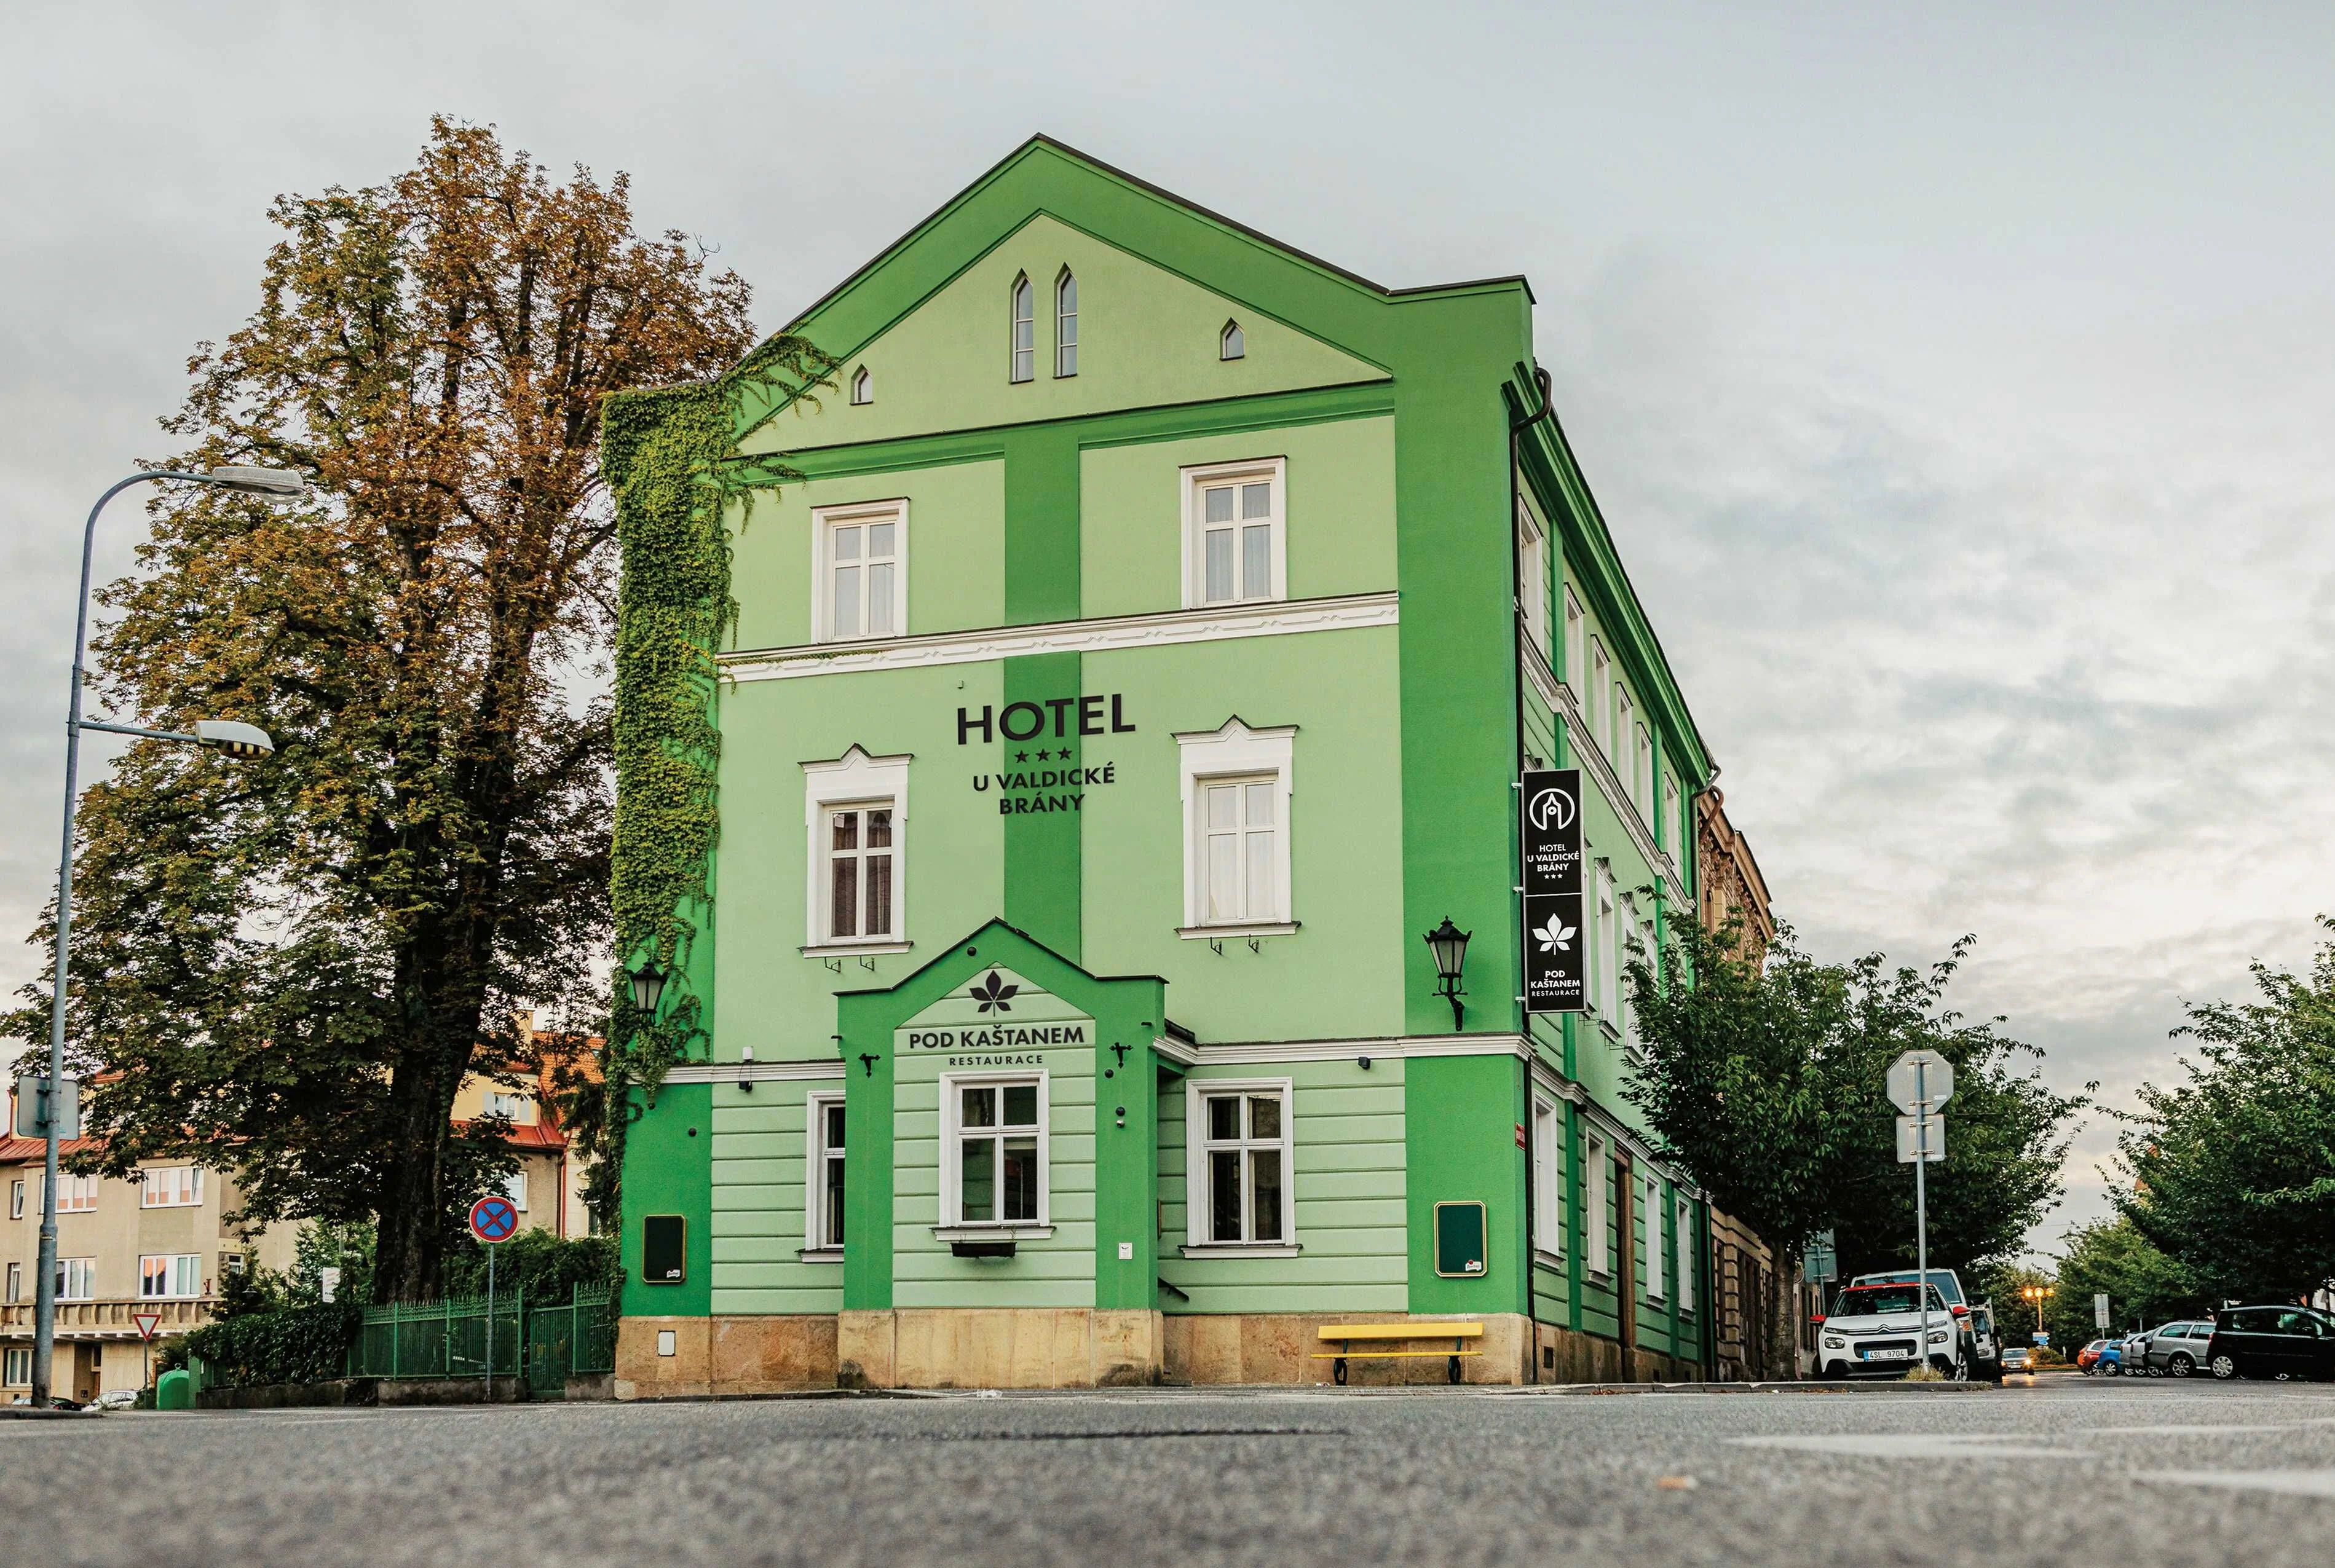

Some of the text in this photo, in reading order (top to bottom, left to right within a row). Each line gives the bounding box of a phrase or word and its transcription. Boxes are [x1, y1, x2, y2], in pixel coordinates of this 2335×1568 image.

[957, 693, 1136, 745] HOTEL
[973, 761, 1115, 792] U VALDICKÉ
[1000, 792, 1086, 814] BRÁNY
[1536, 851, 1579, 862] VALDICKÉ
[1537, 862, 1569, 872] BRÁNY
[1530, 979, 1581, 988] KAŠTANEM
[910, 1025, 1085, 1049] POD KAŠTANEM
[949, 1055, 1043, 1066] RESTAURACE
